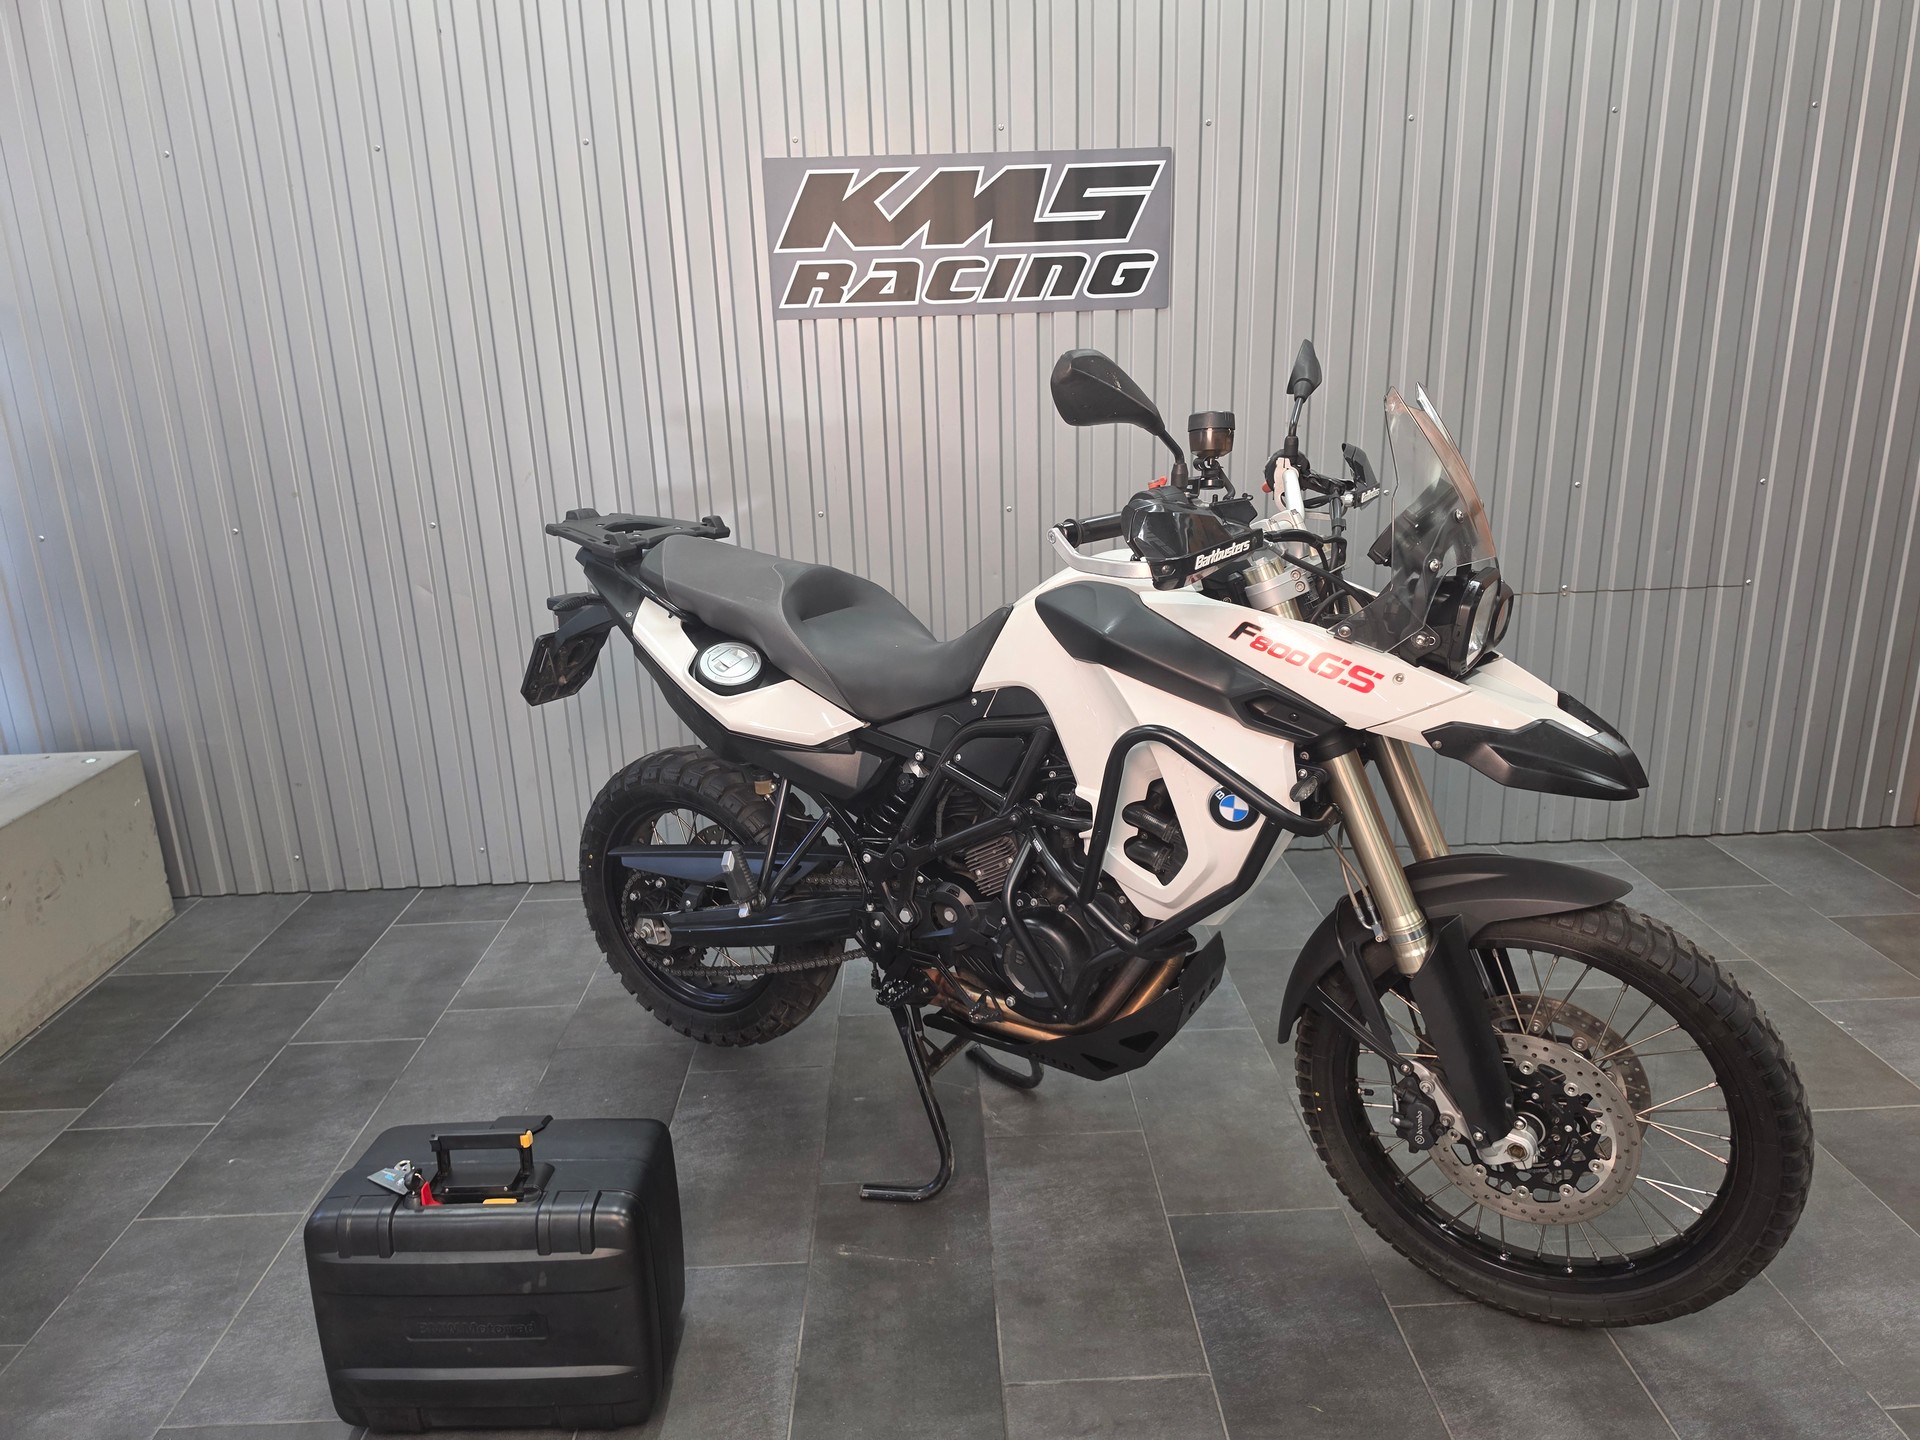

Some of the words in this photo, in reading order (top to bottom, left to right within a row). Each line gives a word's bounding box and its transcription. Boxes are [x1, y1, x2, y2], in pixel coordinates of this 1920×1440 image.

[773, 160, 1167, 253] KMS
[778, 249, 1159, 308] RACING
[1194, 540, 1251, 570] Barkbusters
